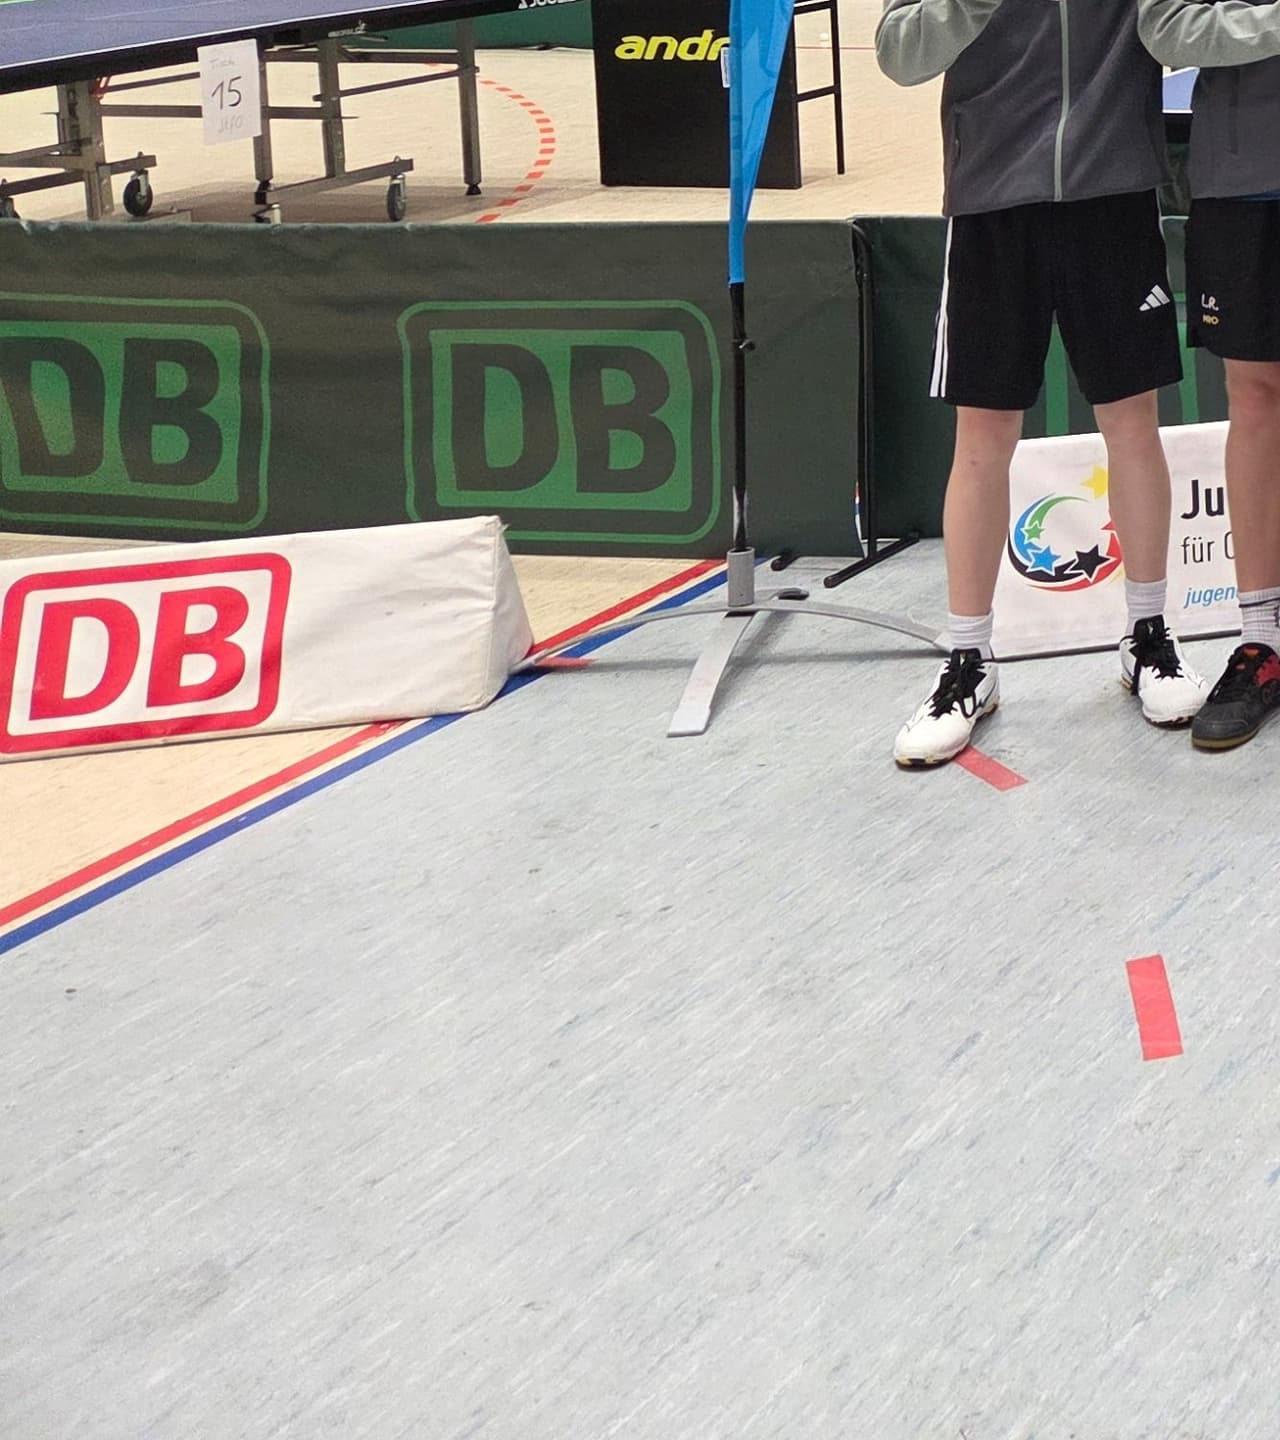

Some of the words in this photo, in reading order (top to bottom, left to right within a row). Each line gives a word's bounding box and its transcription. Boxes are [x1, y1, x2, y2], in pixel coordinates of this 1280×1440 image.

[614, 28, 730, 62] andr
[211, 76, 242, 110] 15
[450, 343, 677, 494] DB
[1181, 536, 1215, 565] für
[29, 586, 249, 721] DB
